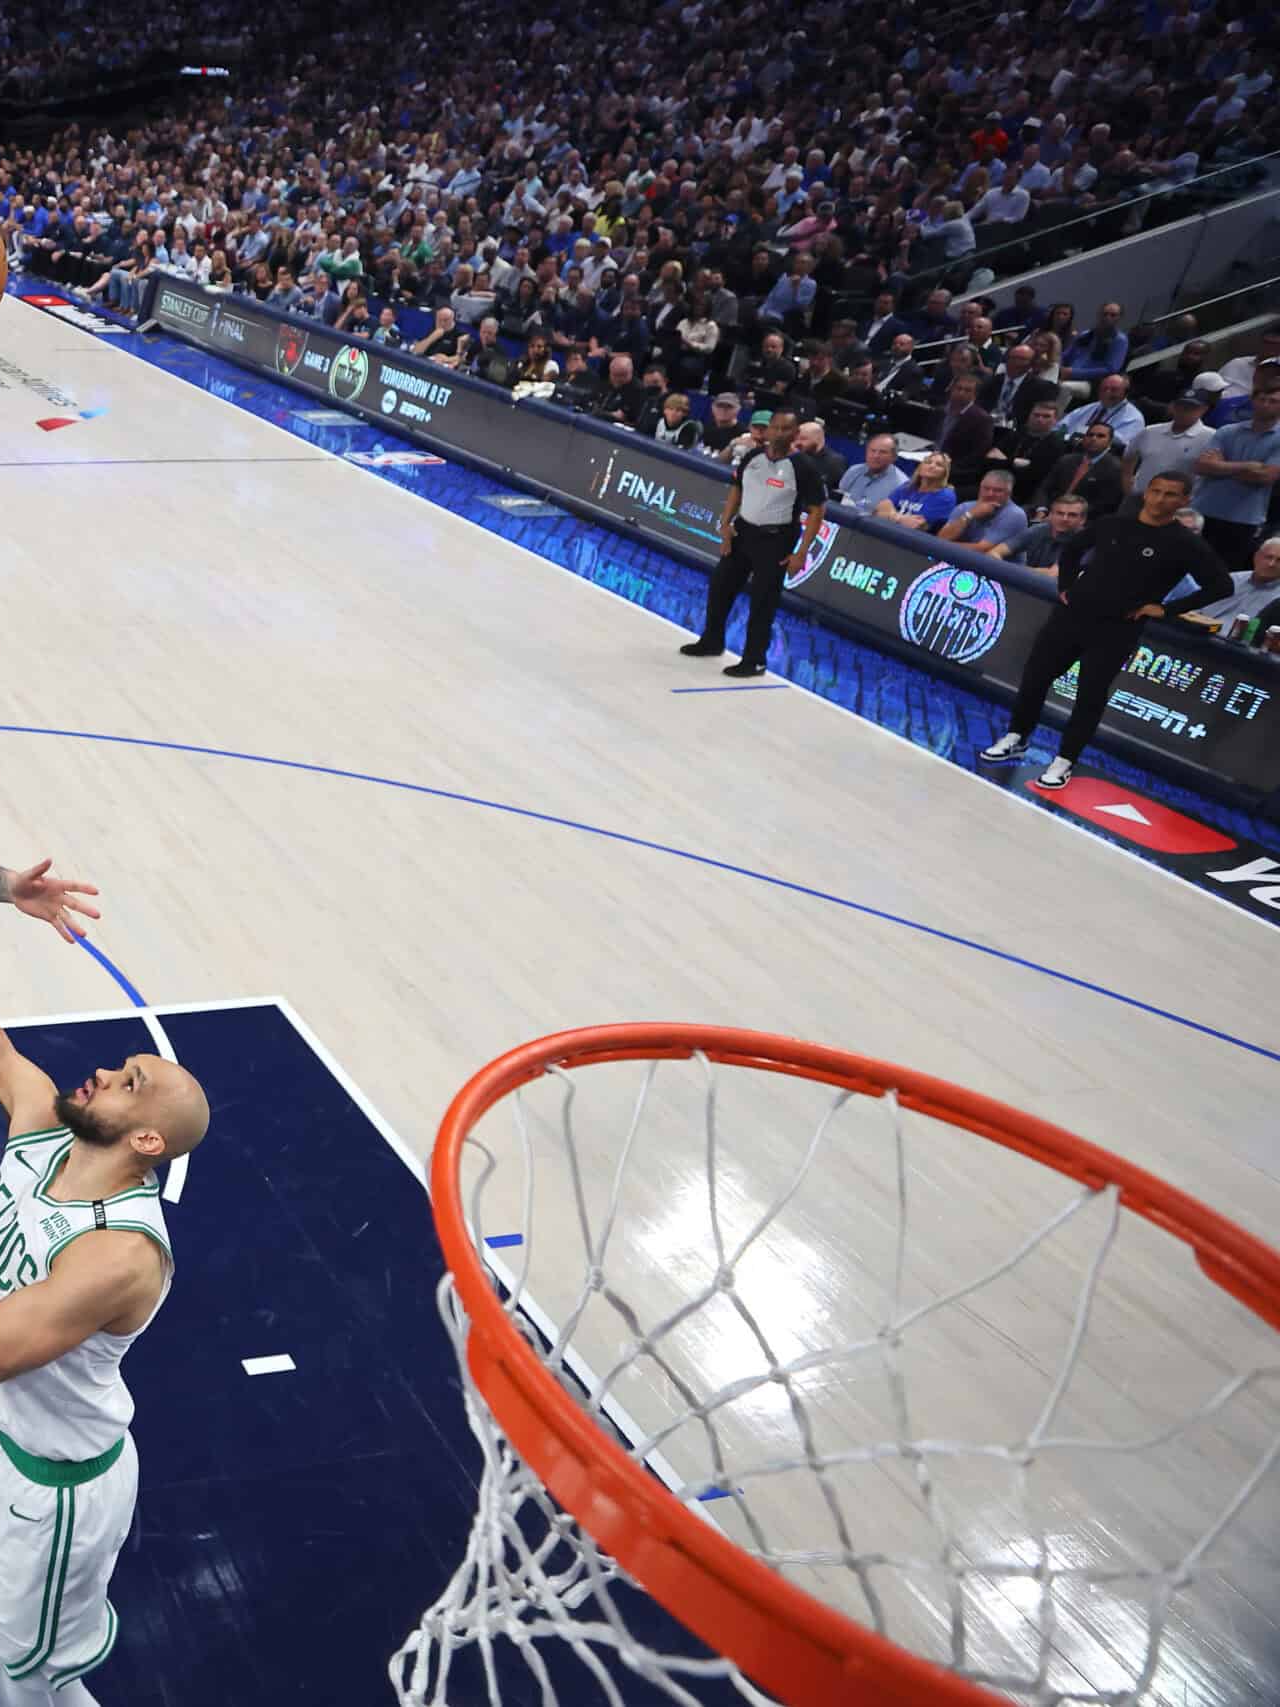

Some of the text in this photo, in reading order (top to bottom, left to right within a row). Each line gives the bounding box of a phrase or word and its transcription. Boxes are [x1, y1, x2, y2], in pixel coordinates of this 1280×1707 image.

[379, 364, 432, 399] TOMORROW
[436, 386, 453, 408] ET
[616, 470, 677, 515] FINAL
[829, 556, 899, 601] GAME 3
[1106, 687, 1208, 740] ESPN+
[1223, 681, 1271, 720] ET
[39, 1218, 61, 1243] PRINT
[49, 1210, 72, 1236] VISTA
